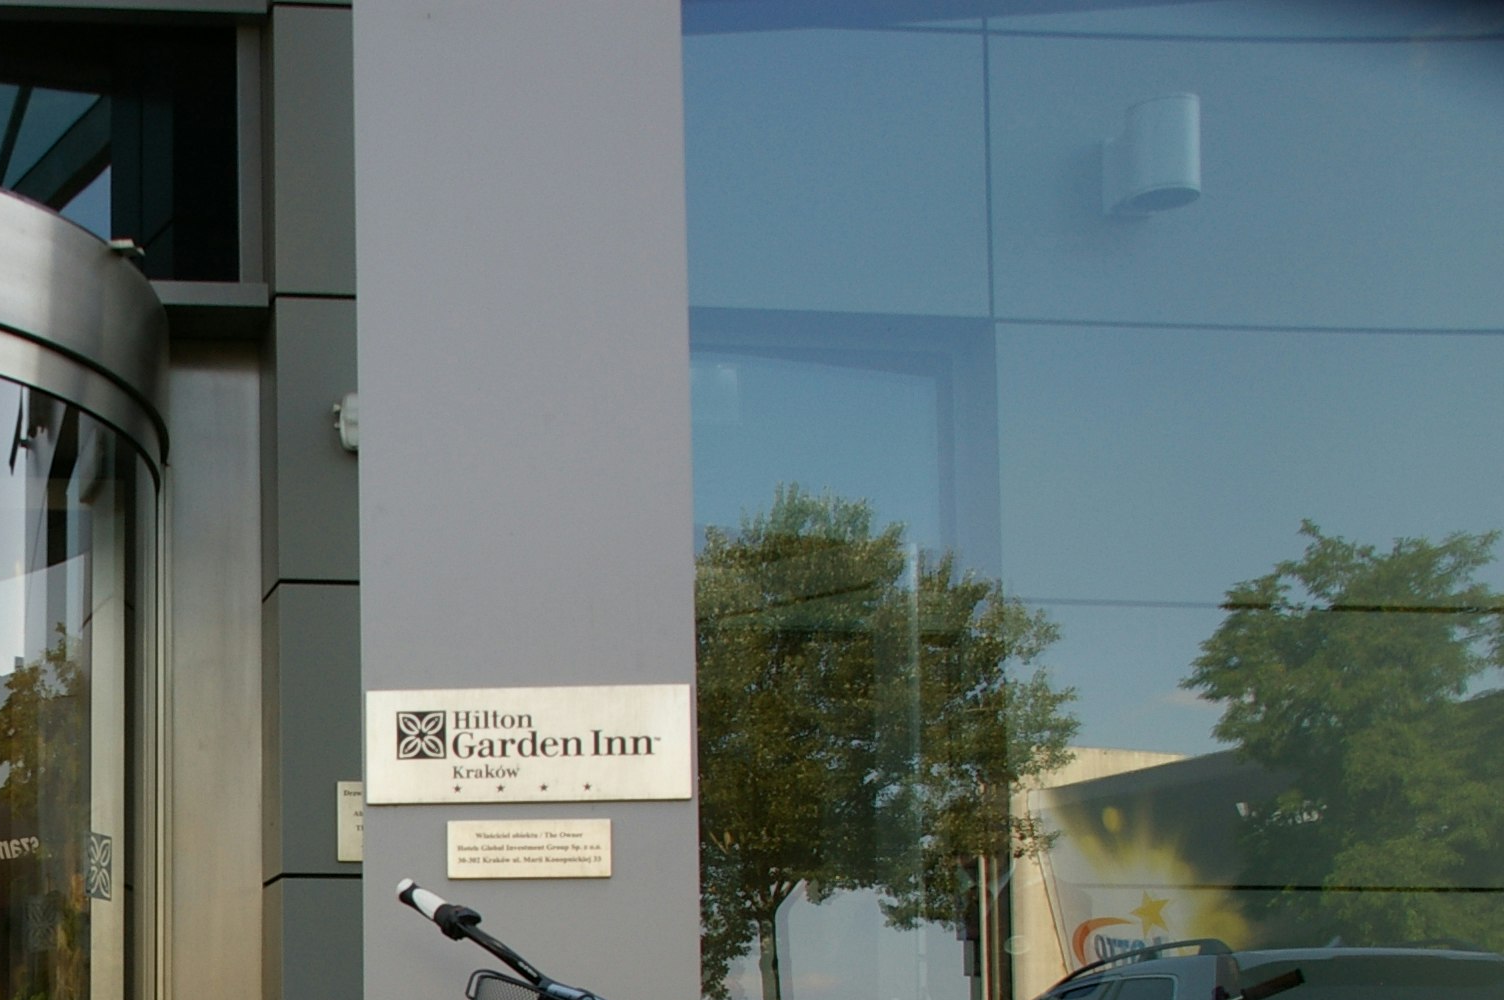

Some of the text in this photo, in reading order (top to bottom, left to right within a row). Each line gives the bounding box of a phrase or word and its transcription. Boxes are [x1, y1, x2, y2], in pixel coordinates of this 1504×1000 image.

[453, 710, 533, 731] Hilton
[452, 729, 656, 759] Garden Inn
[453, 764, 520, 780] Kraków
[546, 843, 569, 852] Group
[545, 855, 592, 864] Konopnickiej
